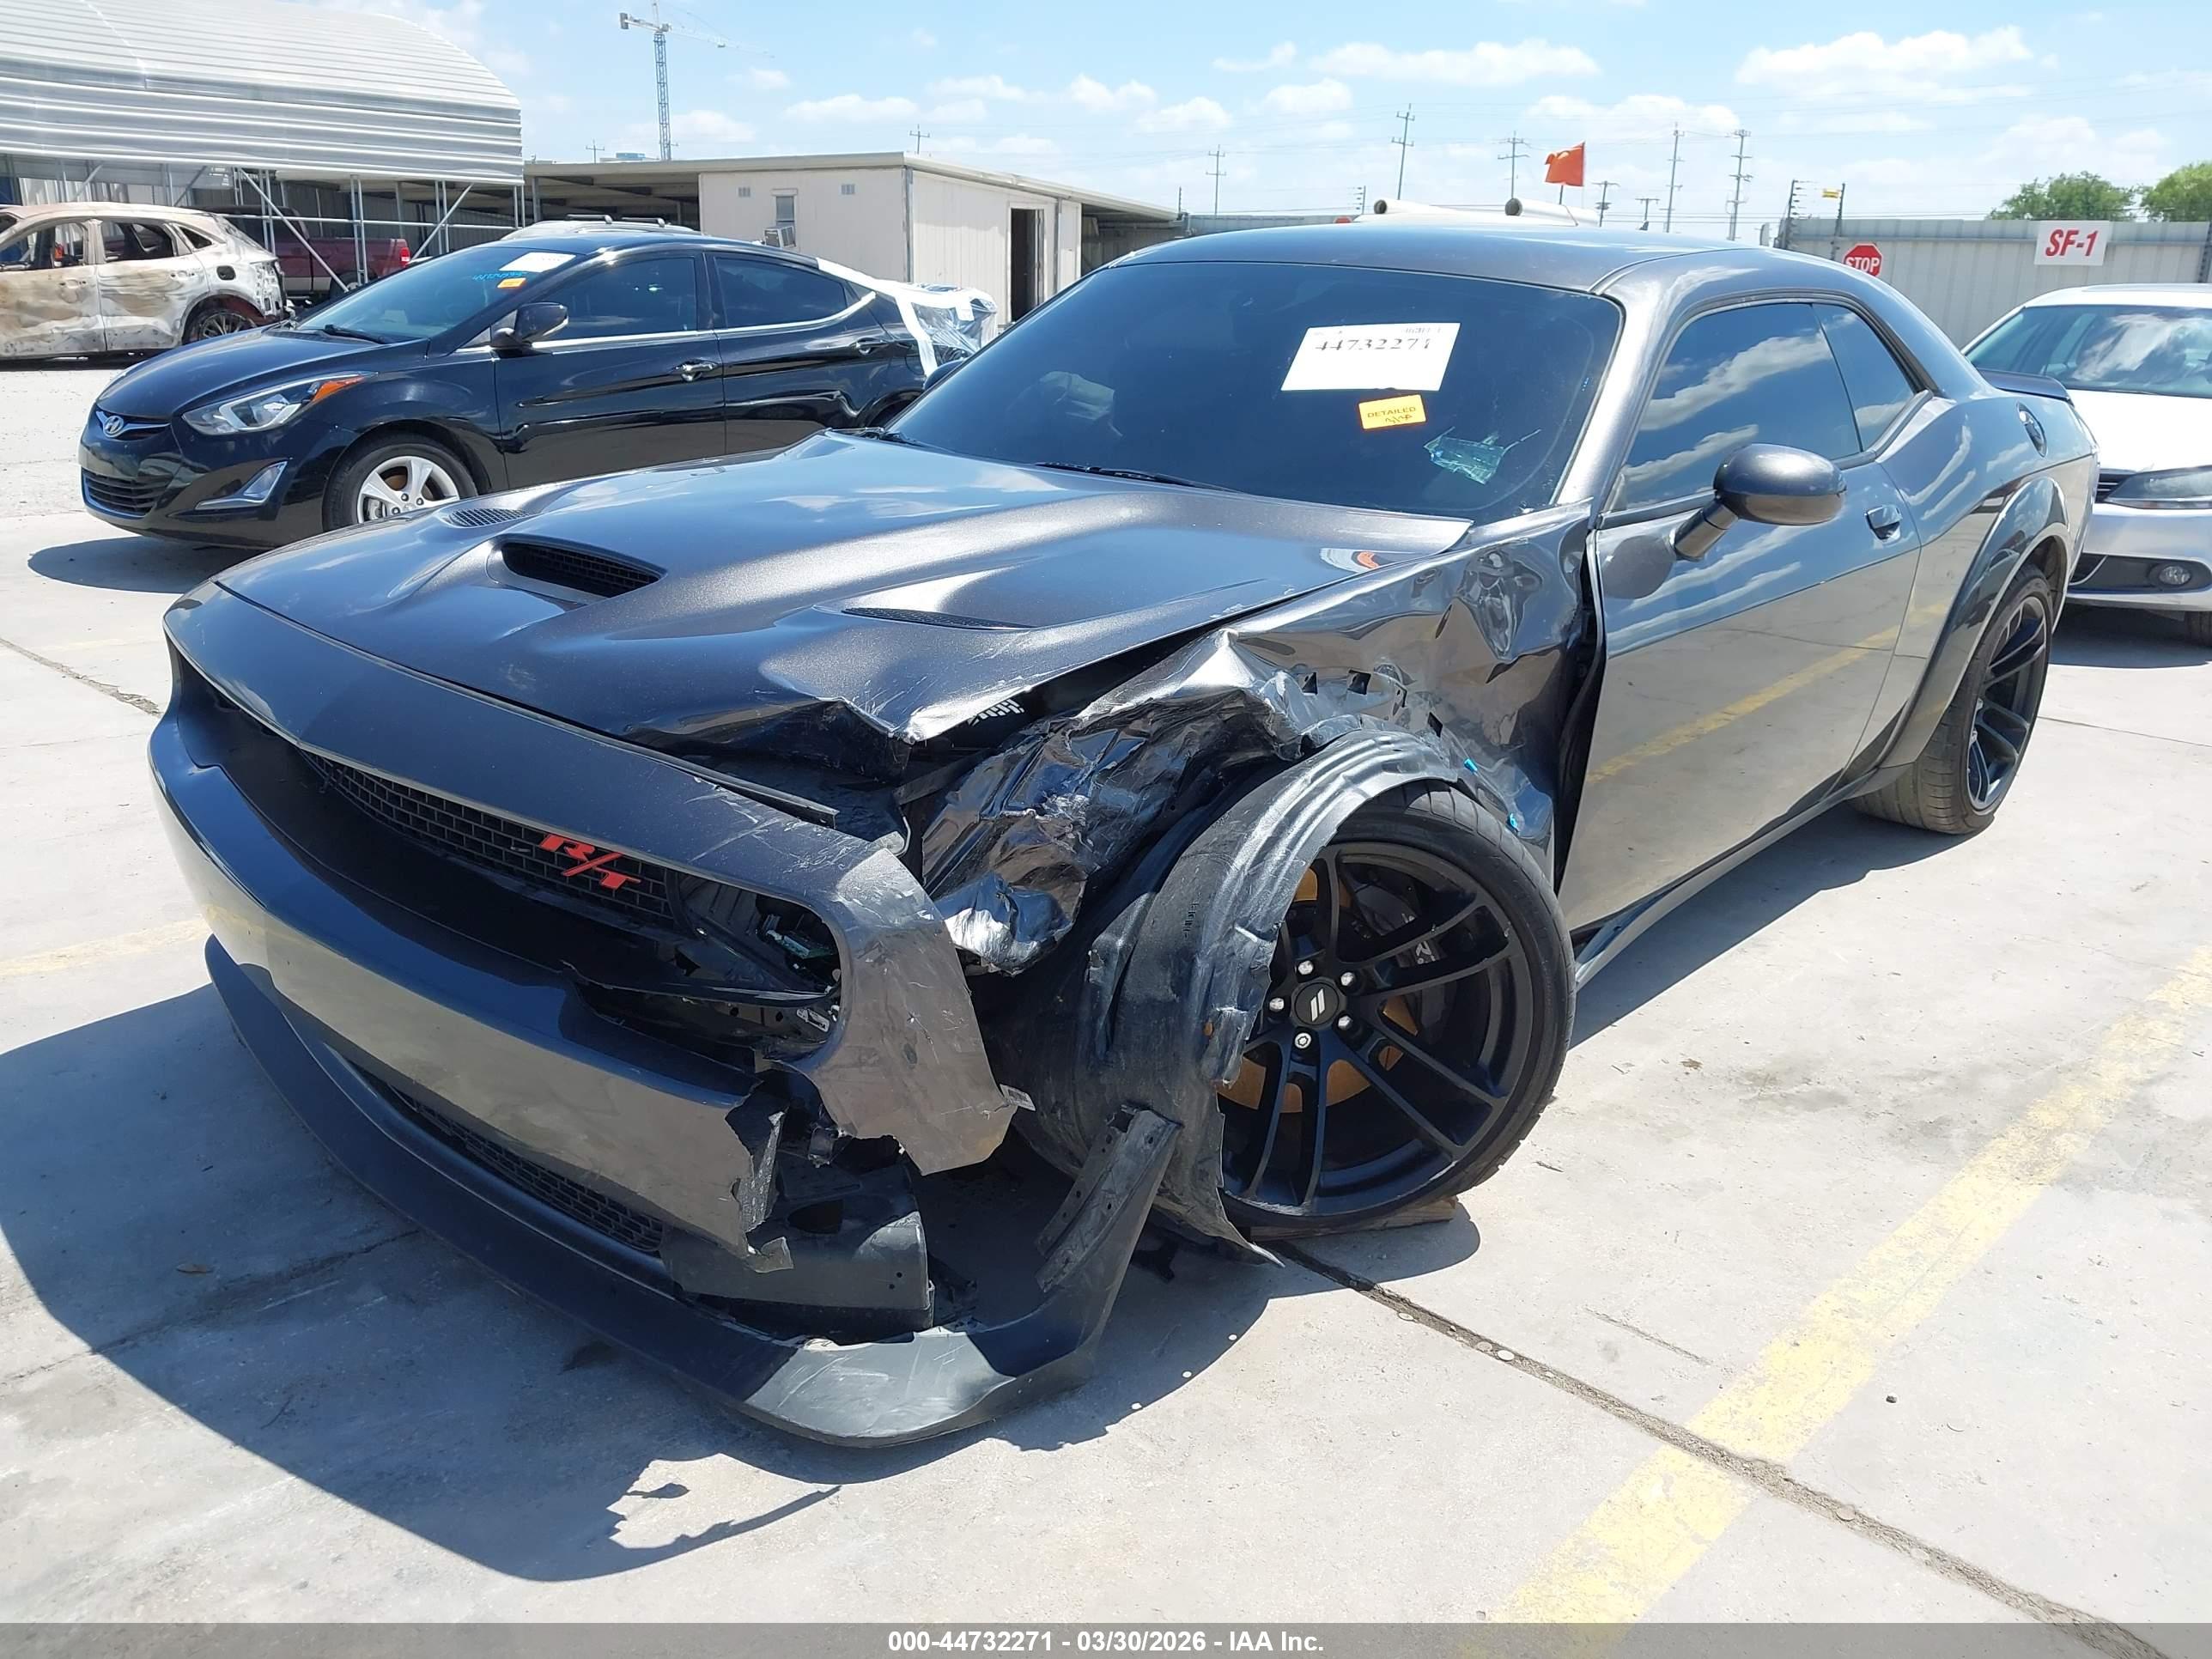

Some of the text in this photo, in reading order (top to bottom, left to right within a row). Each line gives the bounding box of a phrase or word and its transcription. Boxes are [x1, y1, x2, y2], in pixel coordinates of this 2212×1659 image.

[2045, 229, 2098, 257] SF-1
[1844, 256, 1881, 273] STOP
[1366, 406, 1416, 418] DETAILED
[539, 833, 641, 890] R/T
